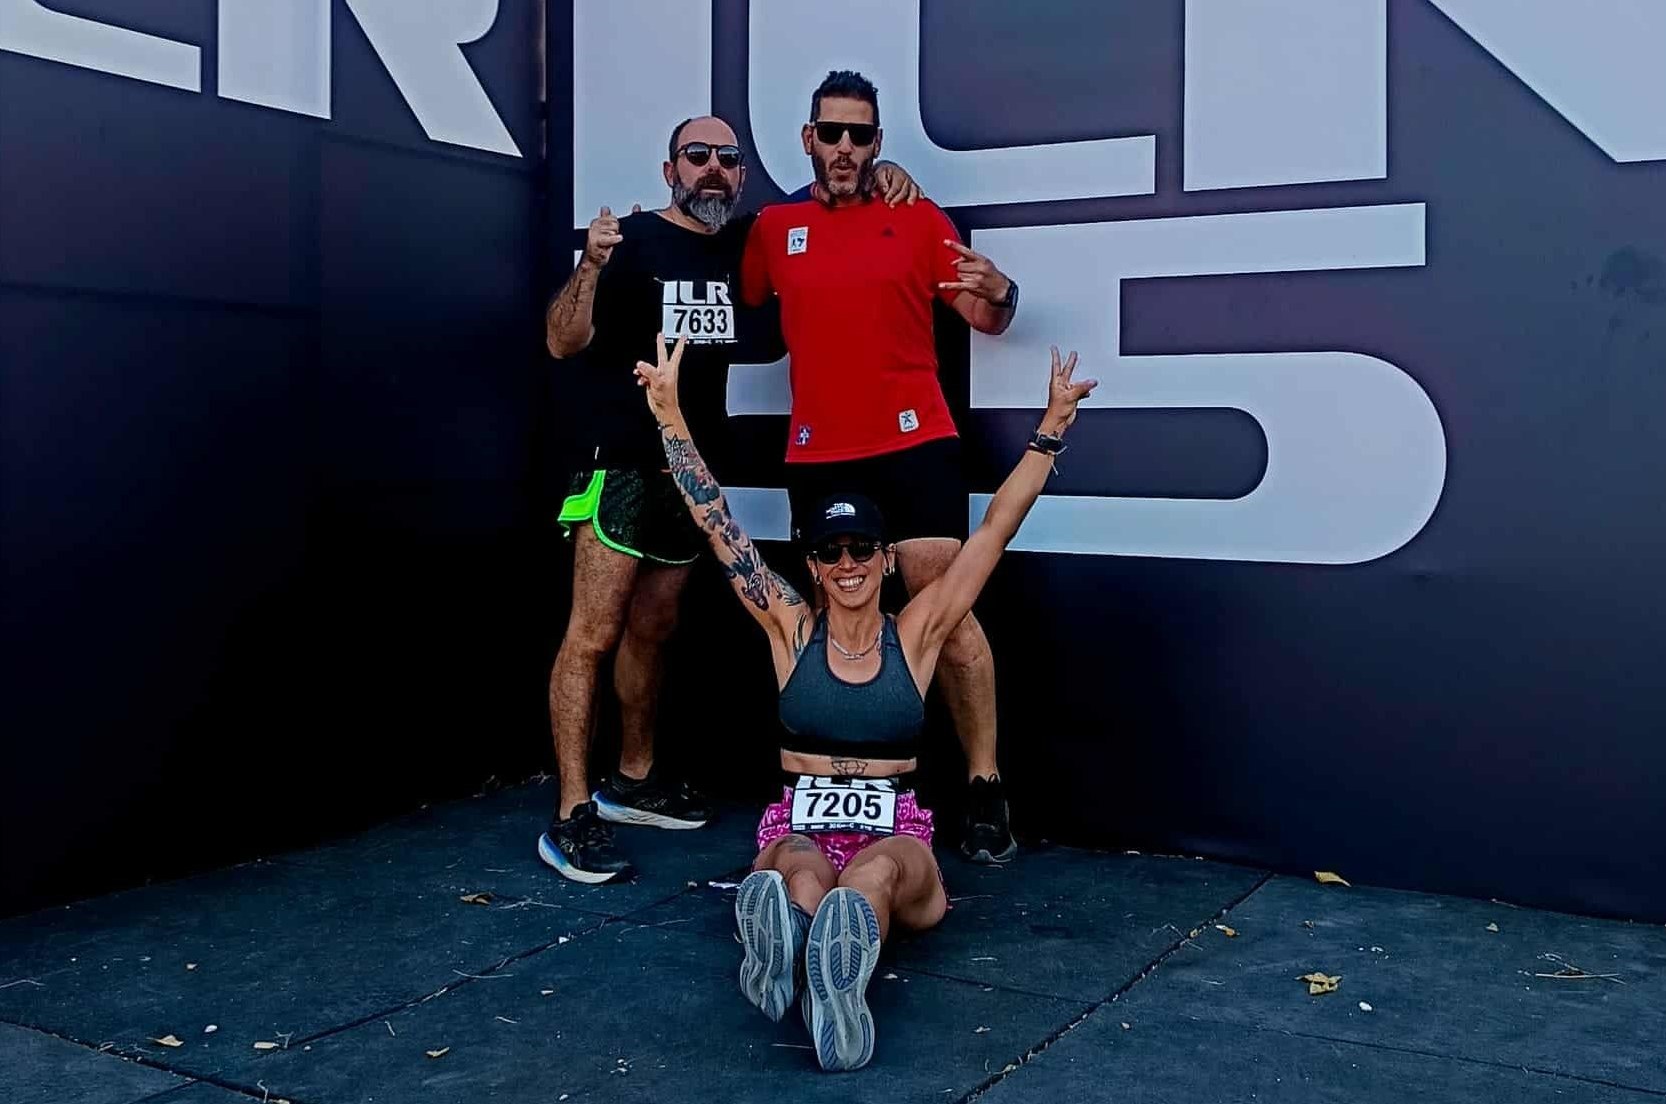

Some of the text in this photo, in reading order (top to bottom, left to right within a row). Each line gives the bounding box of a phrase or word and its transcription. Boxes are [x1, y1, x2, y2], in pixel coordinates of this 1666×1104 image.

[663, 281, 732, 304] ILR
[673, 308, 727, 334] 7633
[806, 792, 882, 820] 7205
